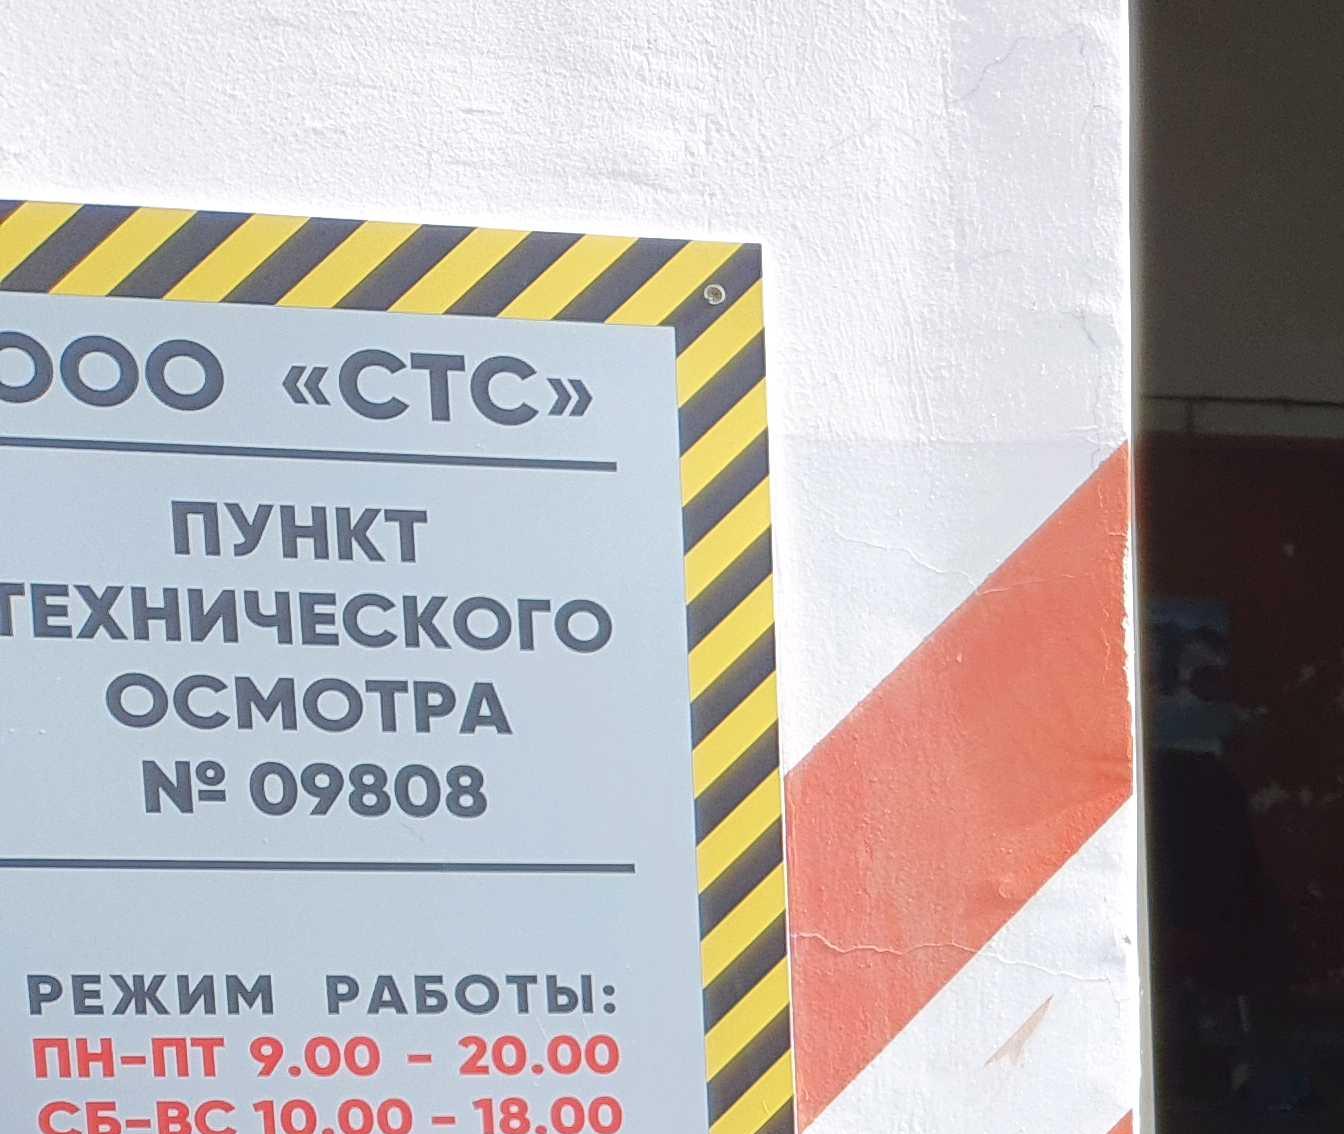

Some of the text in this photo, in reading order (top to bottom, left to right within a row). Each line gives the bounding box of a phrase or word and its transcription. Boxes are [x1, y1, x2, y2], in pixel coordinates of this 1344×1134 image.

[282, 348, 593, 426] «СТС»
[172, 501, 427, 562] ПУНКТ
[0, 582, 612, 652] ТЕХНИЧЕСКОГО
[106, 673, 512, 734] ОСМОТРА
[143, 760, 487, 817] № 09808
[27, 975, 617, 1015] РЕЖИМ РАБОТЫ:
[34, 1038, 224, 1078] ПН-ПТ
[249, 1036, 381, 1078] 9.00
[460, 1036, 619, 1075] 20.00
